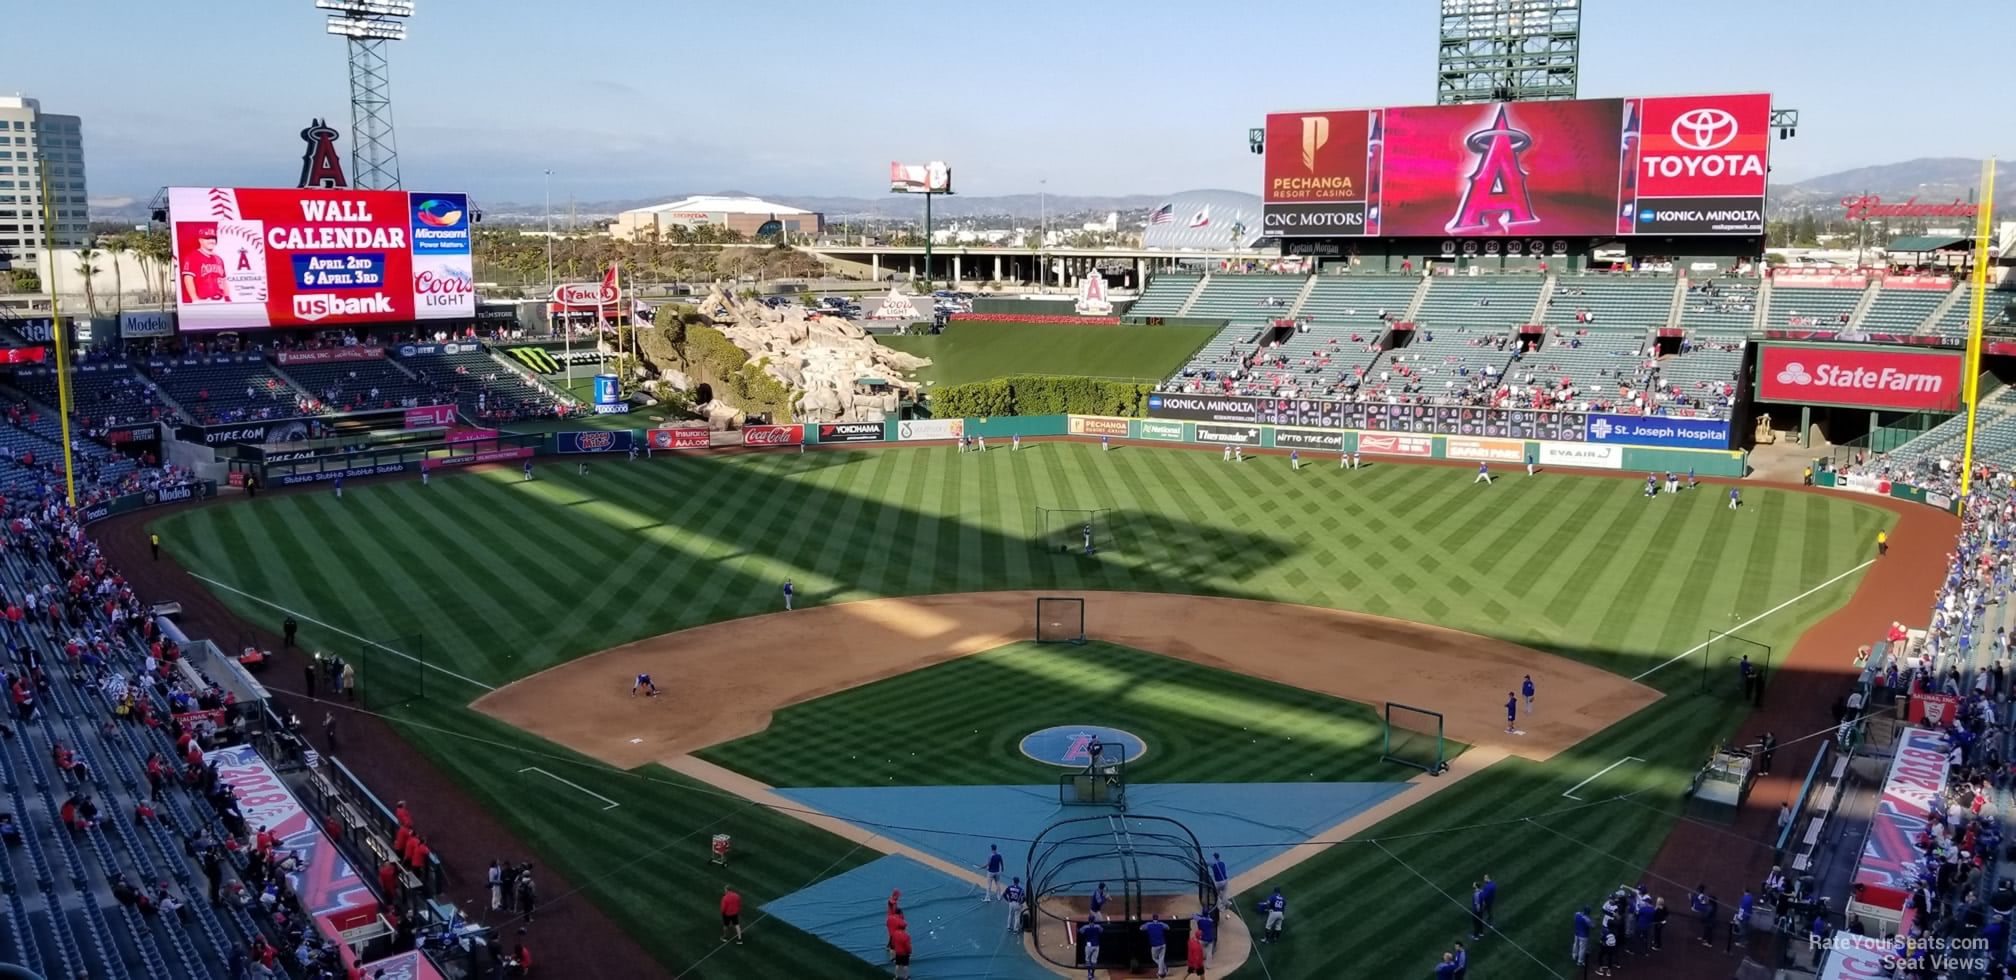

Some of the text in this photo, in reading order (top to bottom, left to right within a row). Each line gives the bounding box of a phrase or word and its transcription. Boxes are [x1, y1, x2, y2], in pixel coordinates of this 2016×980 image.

[304, 117, 348, 187] A
[1643, 154, 1764, 178] TOYOTA
[1273, 177, 1352, 189] PECHANGA
[1273, 189, 1353, 198] RESORT CASINO
[300, 200, 372, 222] WALL
[1840, 195, 1995, 220] Budweise
[1264, 212, 1363, 226] CNC MOTORS
[1656, 211, 1761, 222] KONICA MINOLTA
[268, 227, 406, 249] CALENDAR
[415, 228, 467, 239] Microsemi
[419, 241, 439, 249] Power
[1289, 242, 1339, 254] Captain Morgan
[1510, 242, 1520, 250] 30
[1531, 242, 1542, 250] 42
[1554, 242, 1565, 250] 50
[304, 272, 315, 285] &
[414, 271, 472, 294] Coors
[426, 294, 465, 306] LIGHT
[882, 298, 913, 309] Coors
[127, 317, 167, 333] Modelo
[1163, 398, 1255, 413] KONICA MINOLTA
[435, 409, 456, 424] LA
[744, 426, 791, 443] Coca-Cola
[835, 425, 880, 434] YOKOHAMA
[1198, 430, 1248, 441] Thermador
[1614, 425, 1726, 441] St. Joseph Hospital
[1277, 433, 1342, 446] NITTO TIRE.COM
[1550, 449, 1596, 459] EVA AIR
[284, 465, 404, 484] StubHub StubHub StubHub StubHub
[159, 486, 191, 502] Modelo
[1891, 749, 1946, 791] 2018
[221, 766, 288, 807] 2018
